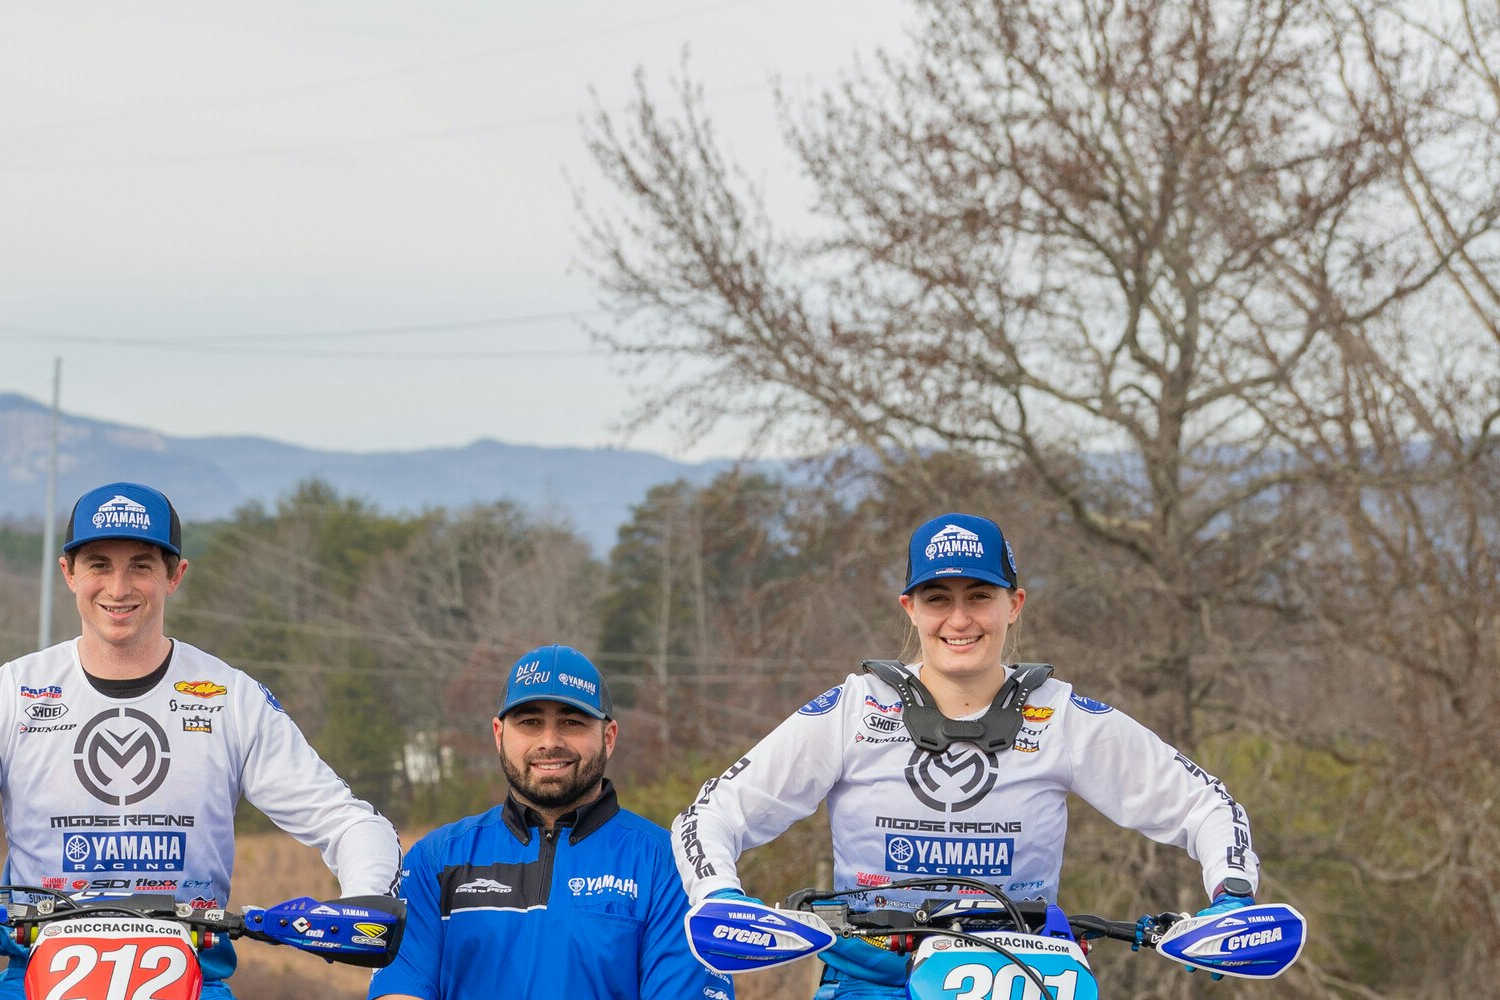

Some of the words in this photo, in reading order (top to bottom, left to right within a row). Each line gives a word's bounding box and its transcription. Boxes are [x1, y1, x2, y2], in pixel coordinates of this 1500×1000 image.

[102, 512, 151, 527] YAMAHA
[937, 541, 984, 554] YAMAHA
[929, 551, 982, 560] RACING
[20, 685, 62, 695] PARTS
[568, 675, 596, 694] YAMAHA
[20, 691, 63, 699] UNLIMITED
[31, 704, 63, 718] SHOEI
[179, 703, 225, 713] SCOTT
[27, 723, 77, 733] DUNLOP
[869, 716, 901, 731] SHOEI
[50, 815, 121, 828] MOOSE
[123, 814, 195, 828] RACING
[875, 816, 947, 832] MOOSE
[949, 821, 1022, 834] RACING
[91, 835, 181, 860] YAMAHA
[915, 840, 1009, 866] YAMAHA
[897, 864, 1002, 875] RACING
[855, 871, 891, 883] TRAMMELL
[587, 875, 638, 898] YAMAHA
[342, 908, 369, 917] YAMAHA
[728, 912, 756, 921] YAMAHA
[1247, 915, 1275, 923] YAMAHA
[713, 924, 773, 947] CYCRA
[1227, 927, 1282, 951] CYCRA
